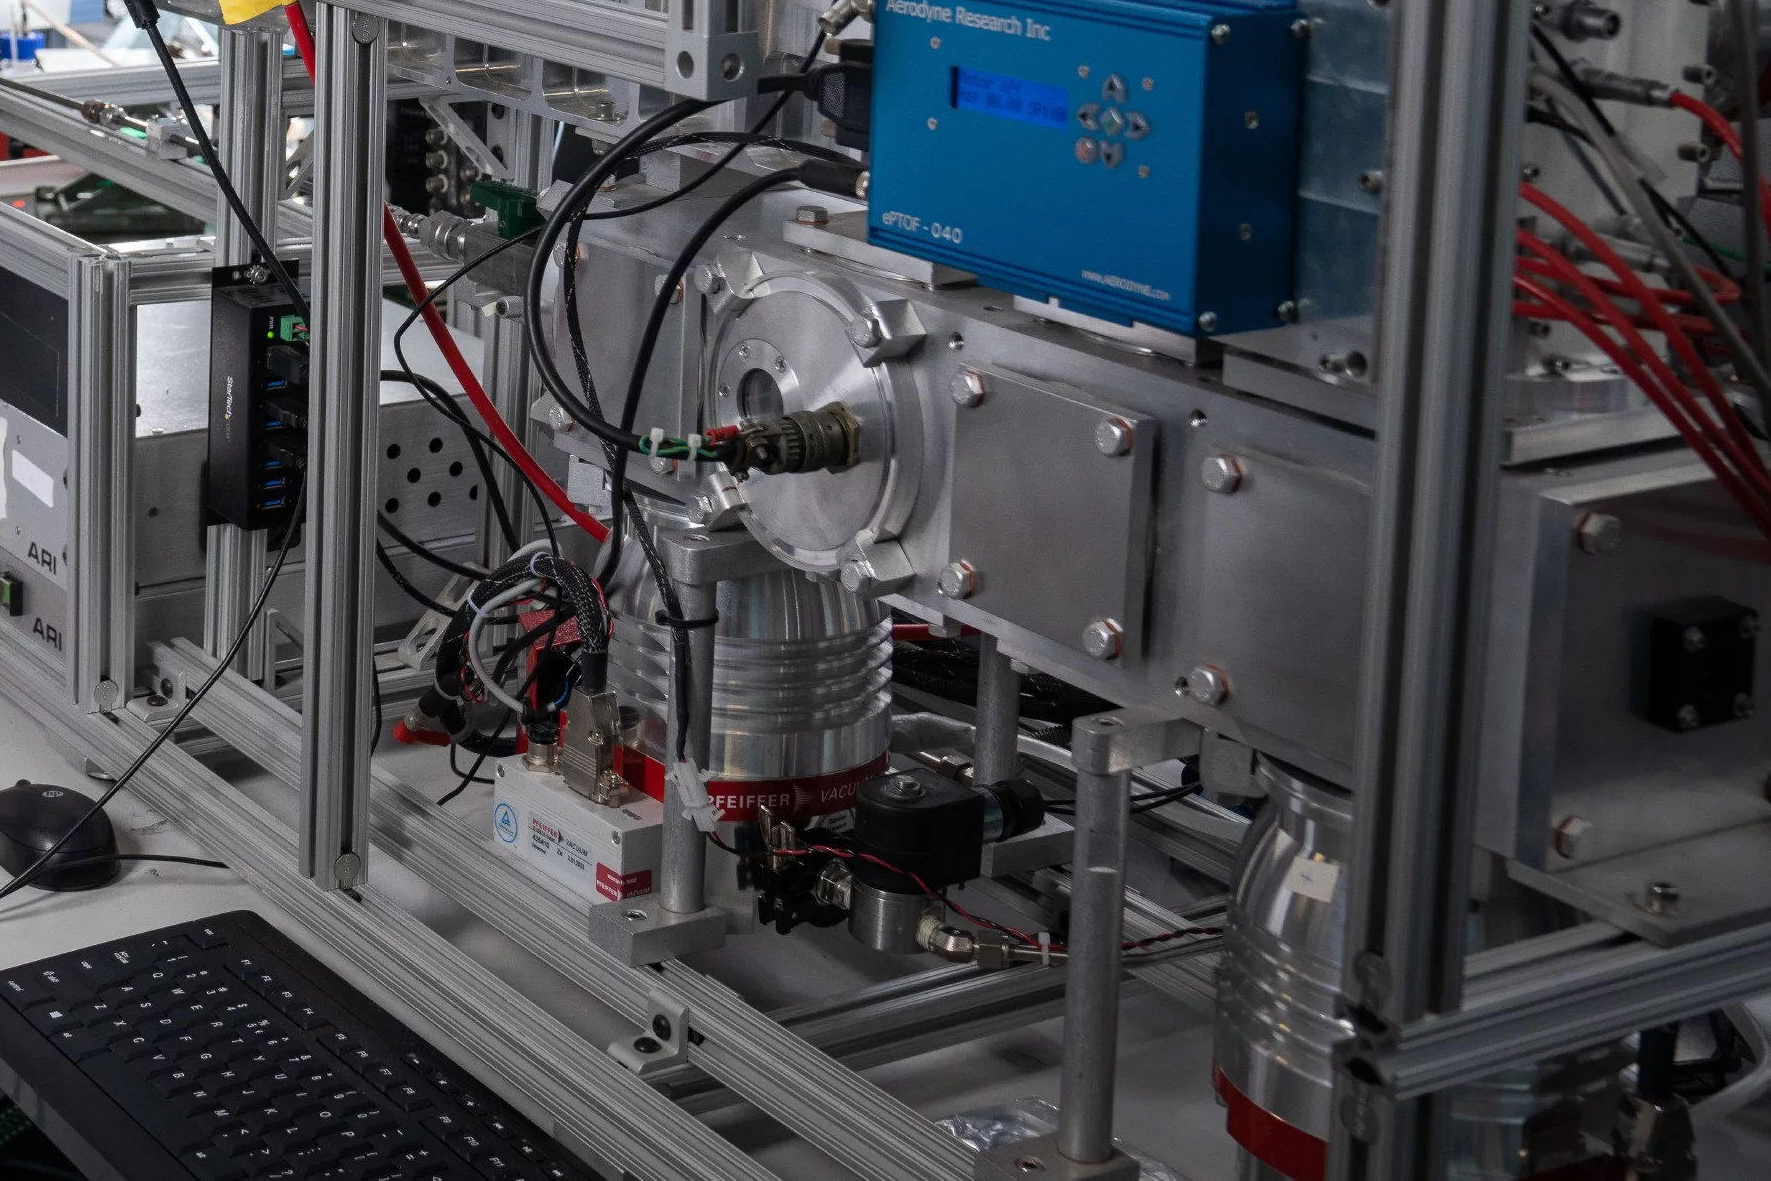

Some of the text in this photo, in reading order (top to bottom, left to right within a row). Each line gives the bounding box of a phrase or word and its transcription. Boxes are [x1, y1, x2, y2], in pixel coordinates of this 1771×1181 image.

[955, 6, 1023, 36] Research
[1025, 18, 1052, 42] Inc
[881, 210, 921, 233] ePTOF
[930, 221, 964, 245] 040
[27, 541, 57, 576] ARI
[32, 617, 62, 652] ARI
[821, 780, 859, 802] VACU
[532, 818, 559, 839] PFEIFFER
[566, 838, 589, 858] VACUUM
